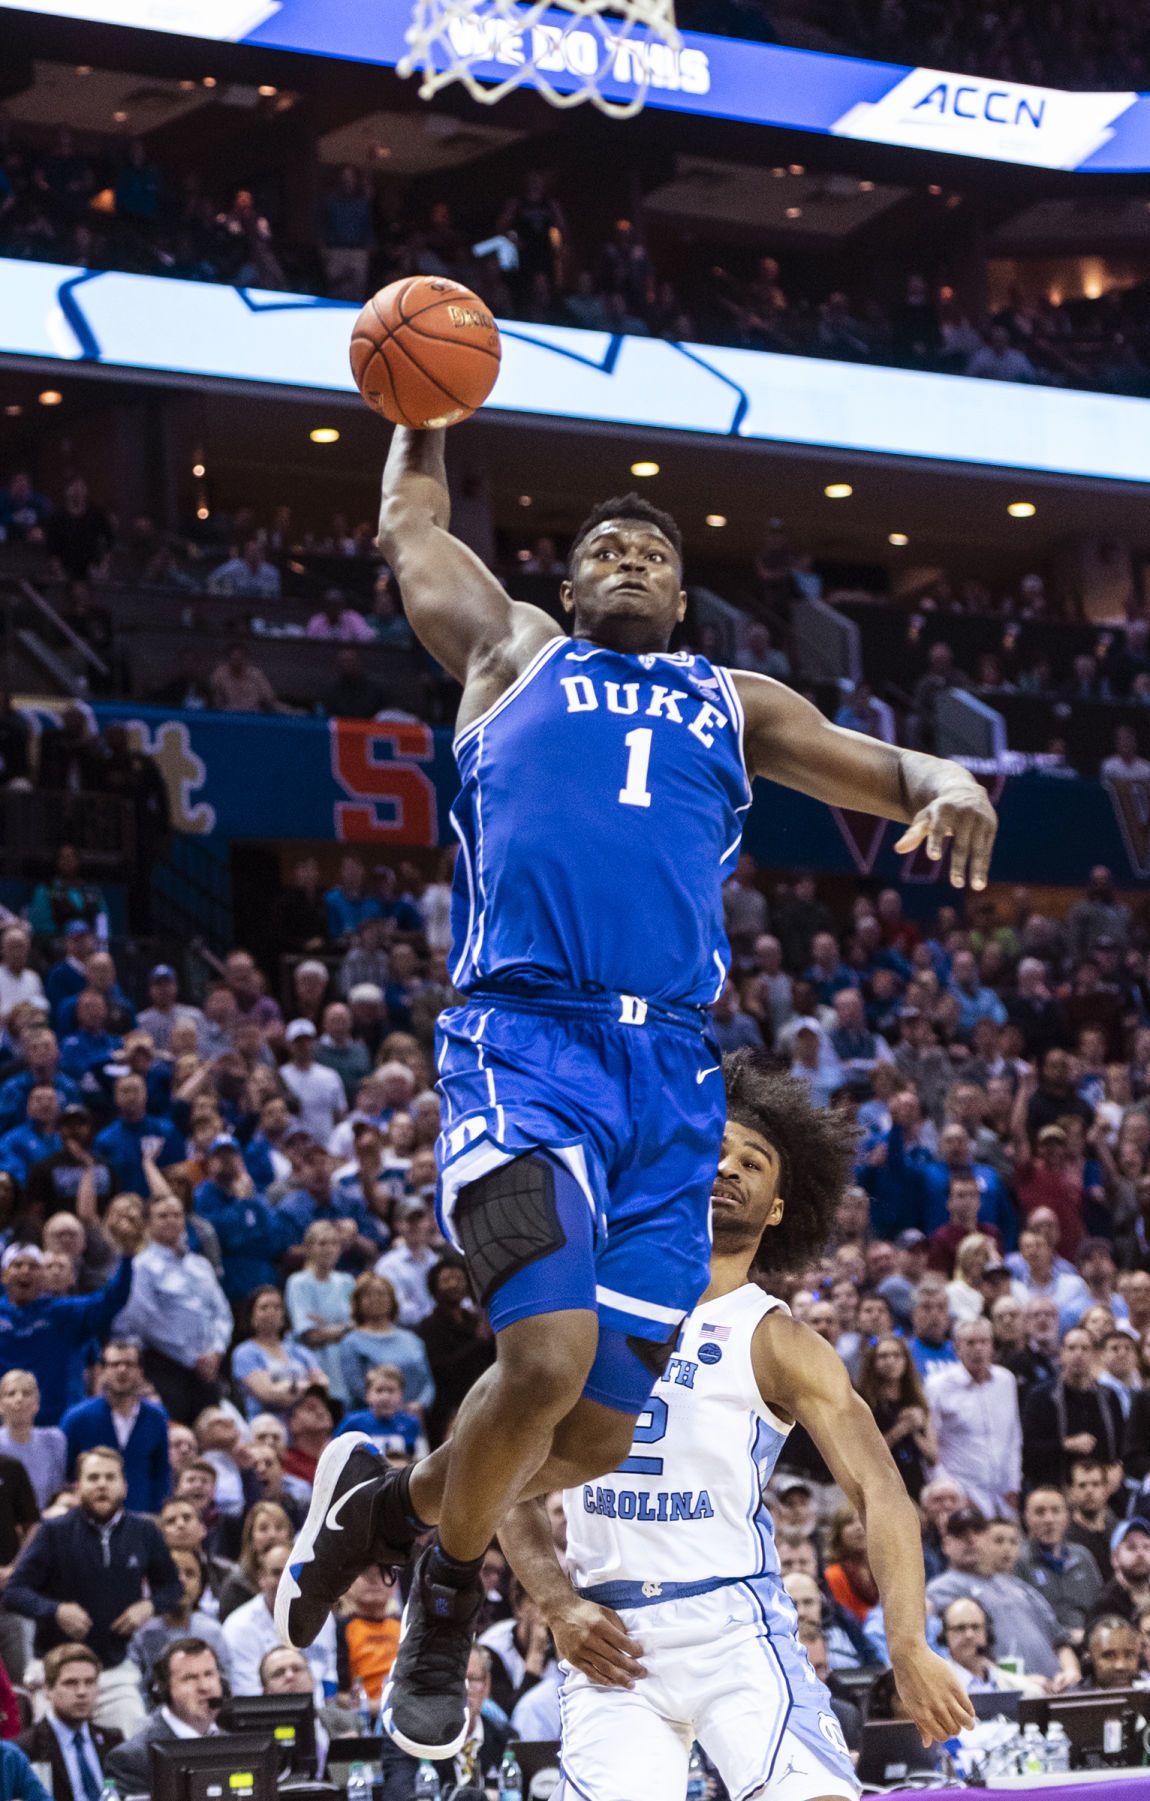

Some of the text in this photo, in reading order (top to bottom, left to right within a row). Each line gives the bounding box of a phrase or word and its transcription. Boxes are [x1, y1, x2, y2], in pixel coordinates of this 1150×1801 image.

[447, 12, 710, 95] WE DO THIS
[913, 83, 1045, 128] ACCN
[560, 675, 729, 749] DUKE
[618, 727, 653, 808] 1
[583, 1484, 715, 1522] CAROLINA
